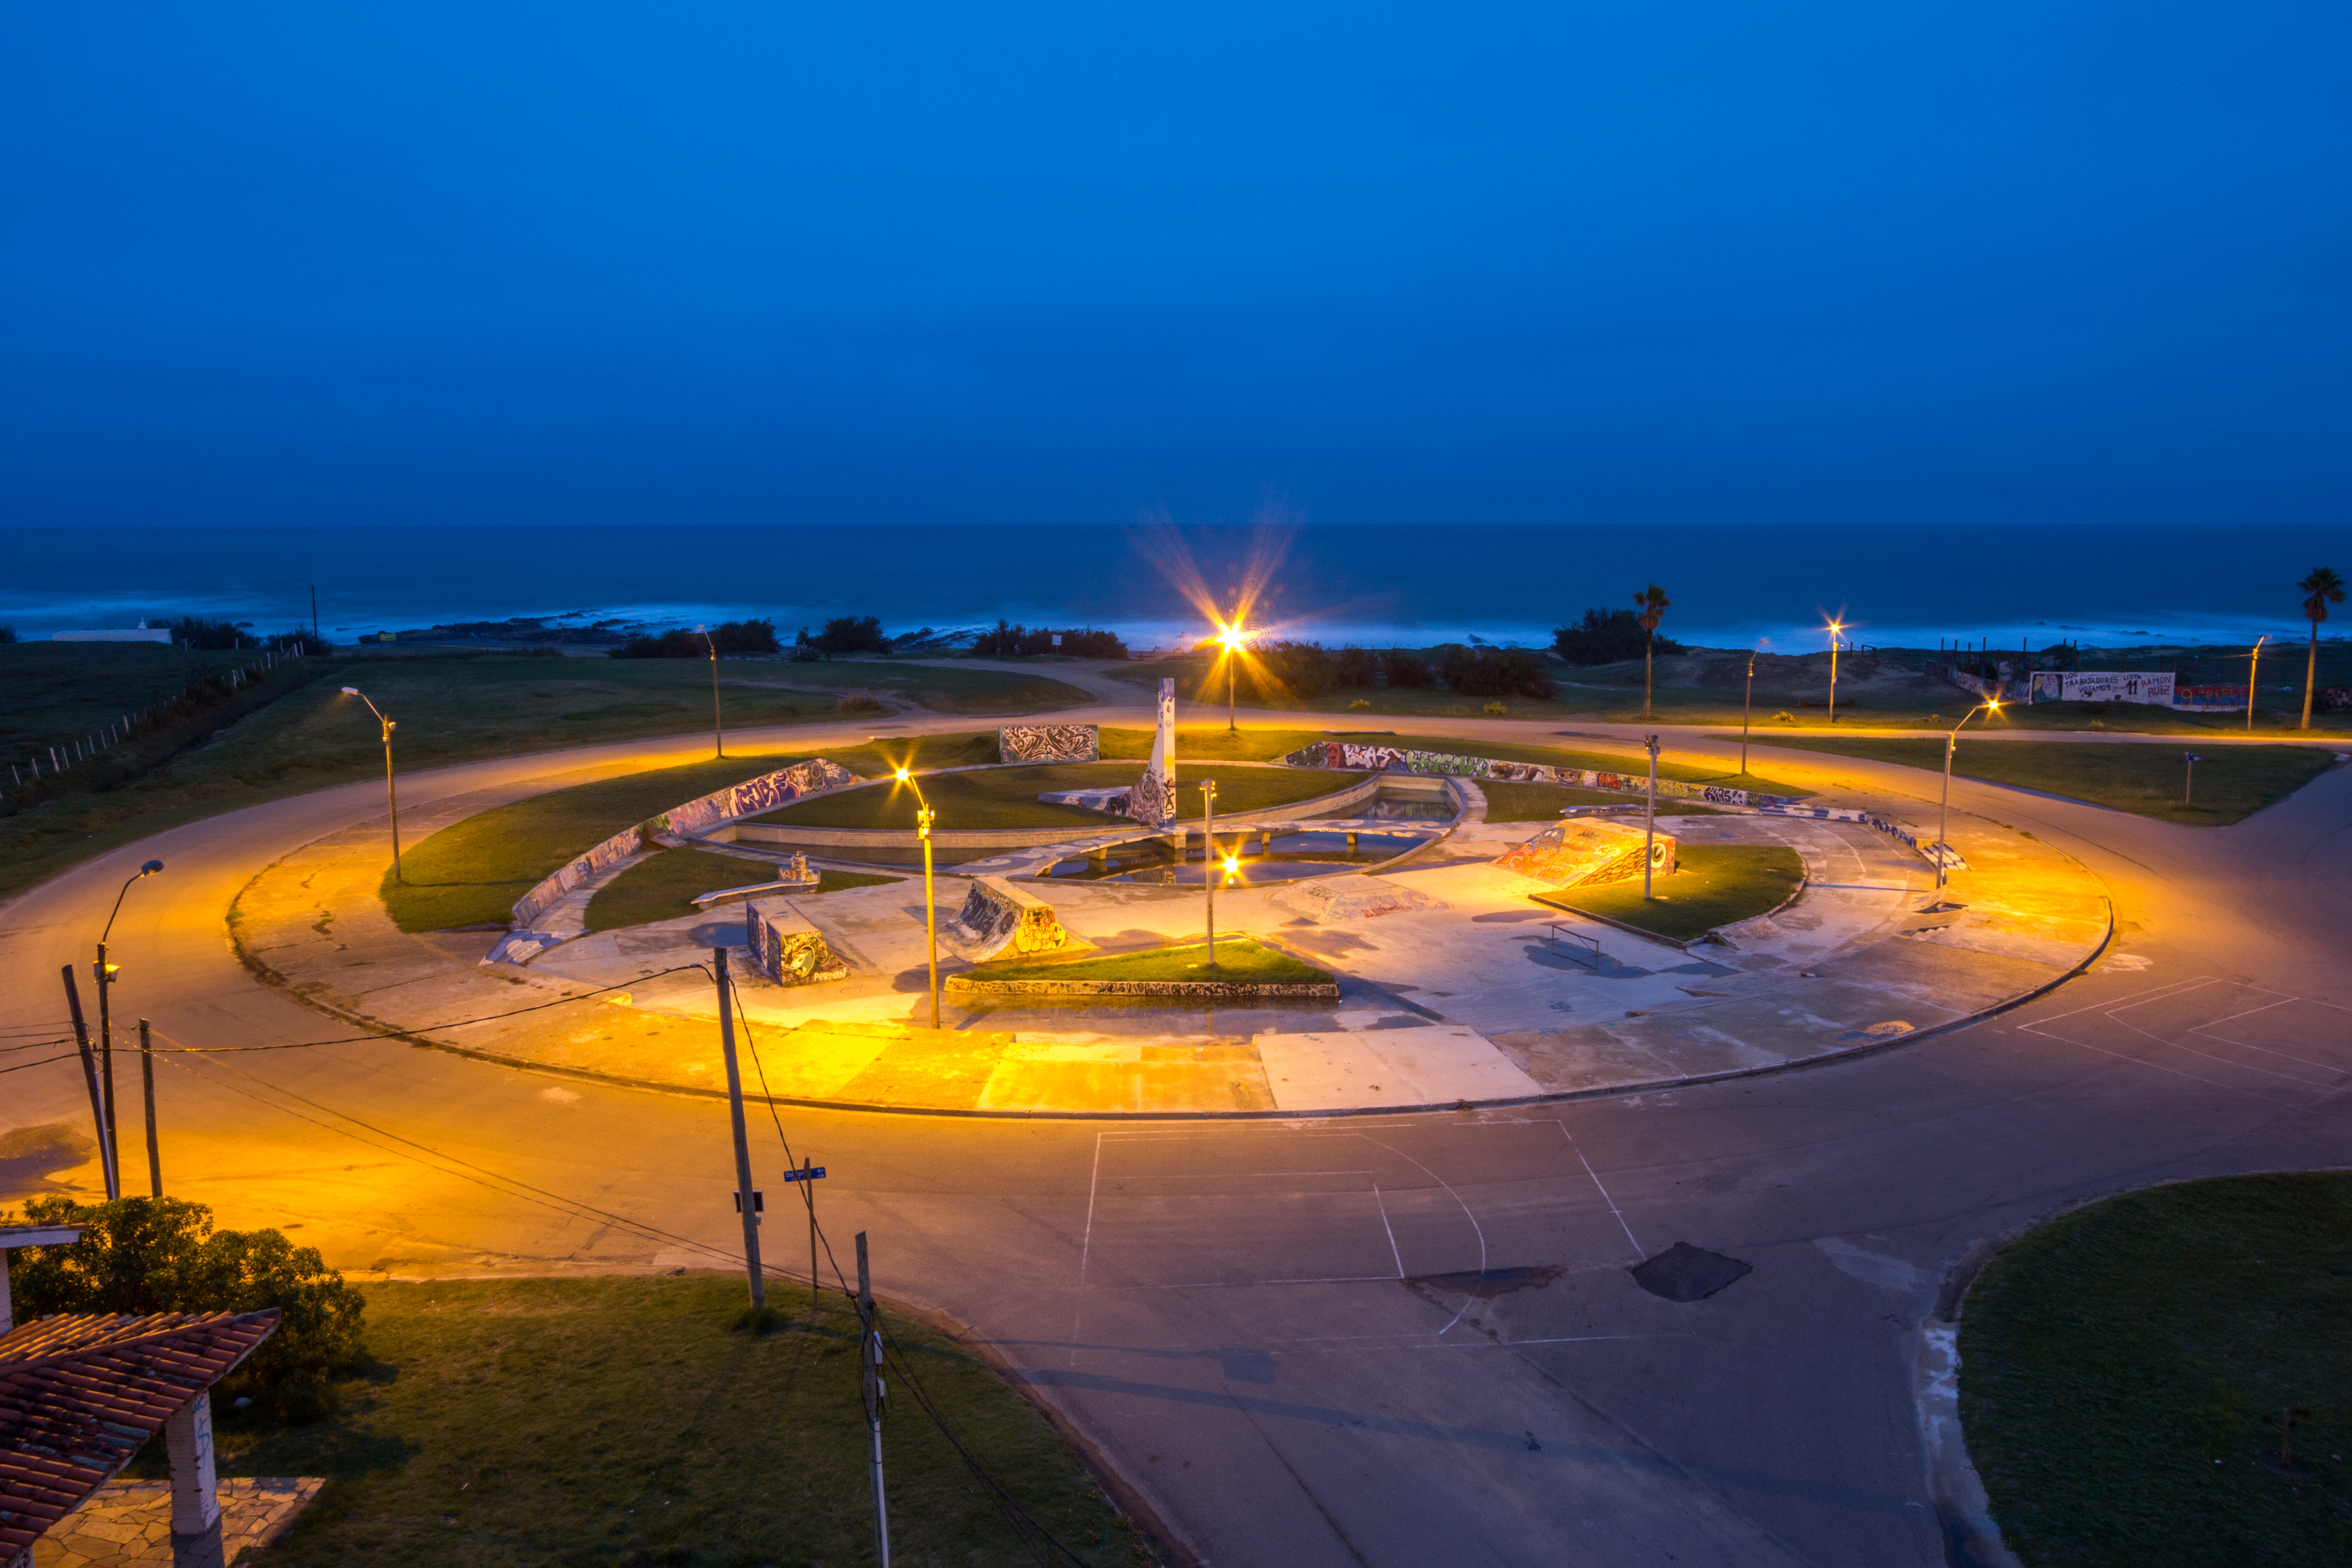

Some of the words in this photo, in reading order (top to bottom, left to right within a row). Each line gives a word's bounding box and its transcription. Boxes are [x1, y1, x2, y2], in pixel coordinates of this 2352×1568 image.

[2064, 676, 2118, 687] TRABAJADORES
[2126, 680, 2138, 695] 11
[2141, 675, 2171, 688] RAMON
[2079, 684, 2111, 693] VOTAMOS
[2147, 685, 2170, 698] RUIZ
[2206, 688, 2235, 701] PEPE
[2180, 688, 2193, 708] 9
